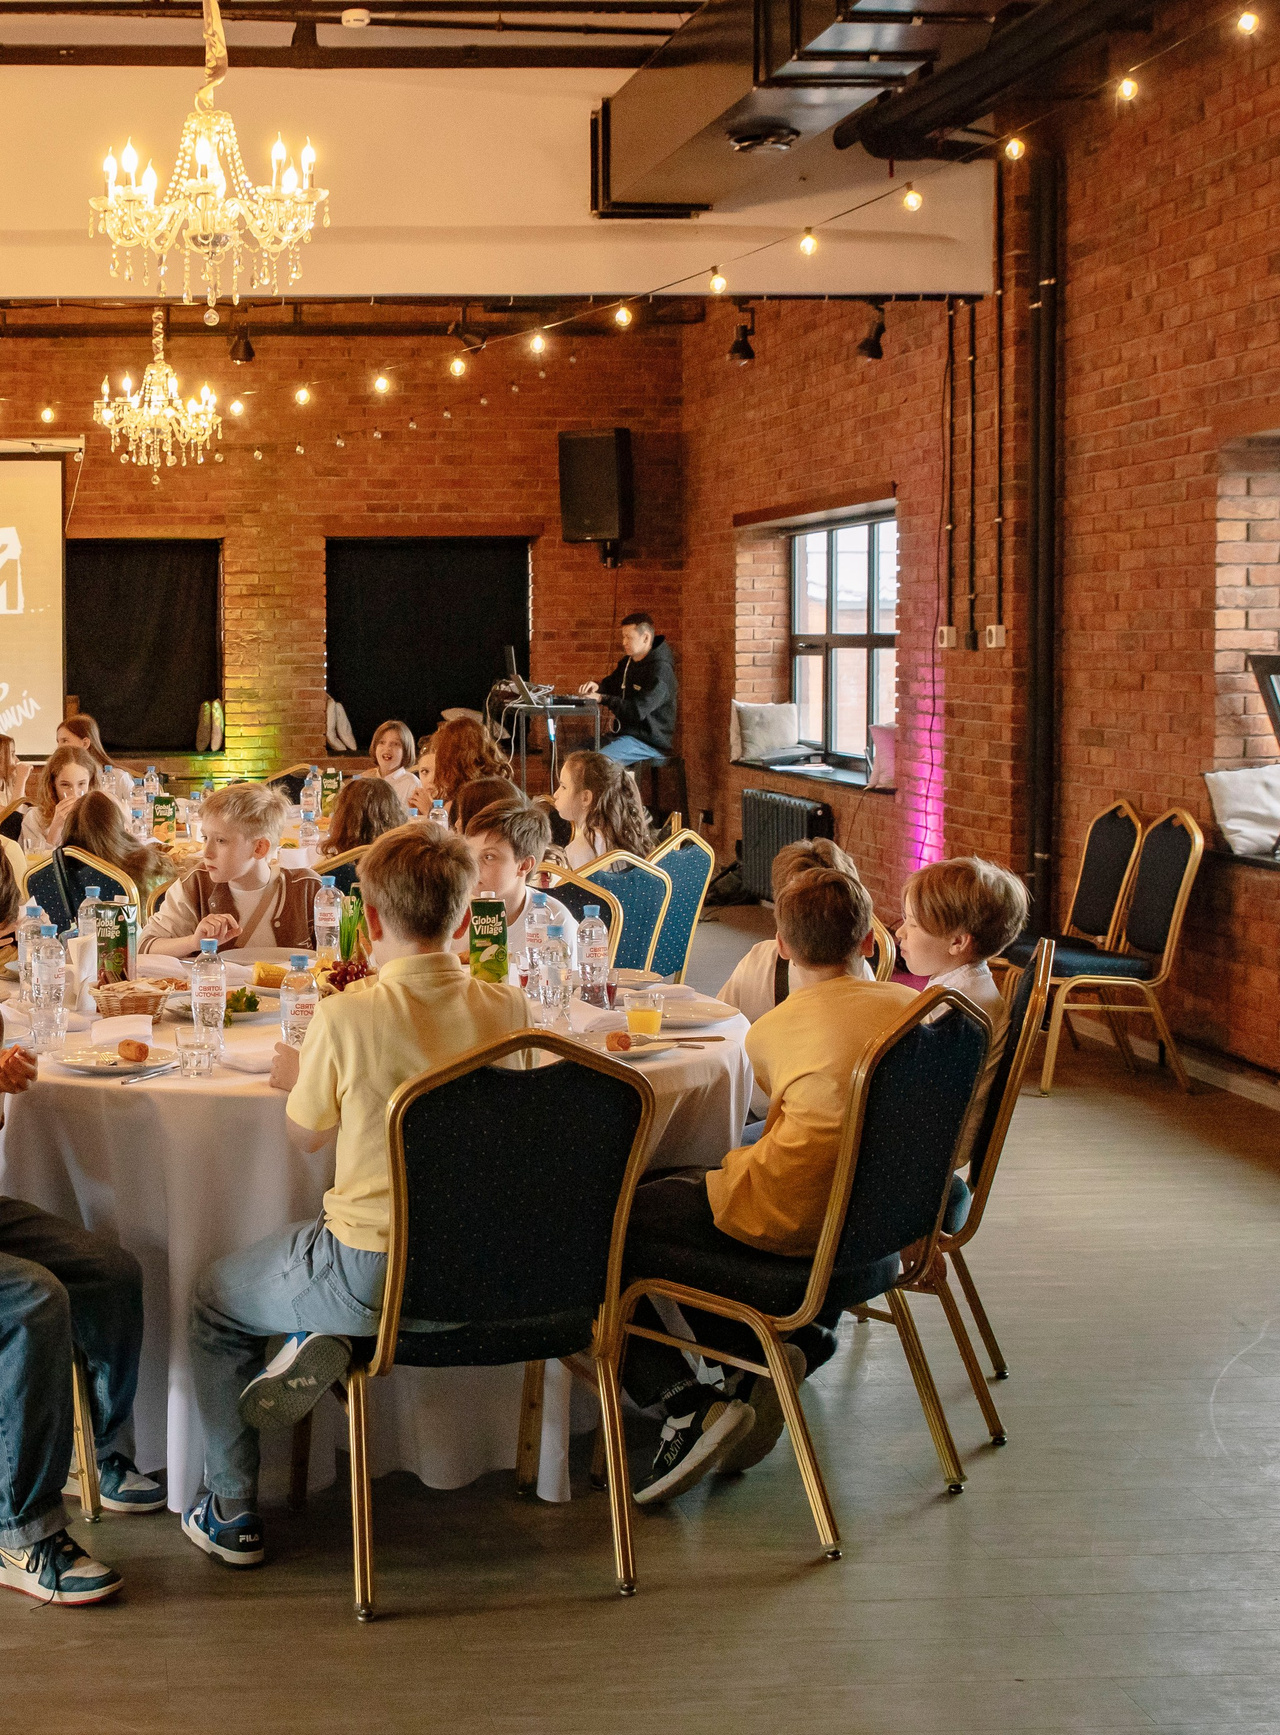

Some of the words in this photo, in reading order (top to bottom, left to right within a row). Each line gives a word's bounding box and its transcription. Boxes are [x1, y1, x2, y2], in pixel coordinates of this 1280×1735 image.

[471, 914, 499, 926] Global
[474, 924, 503, 936] Village
[238, 1533, 260, 1543] FILA
